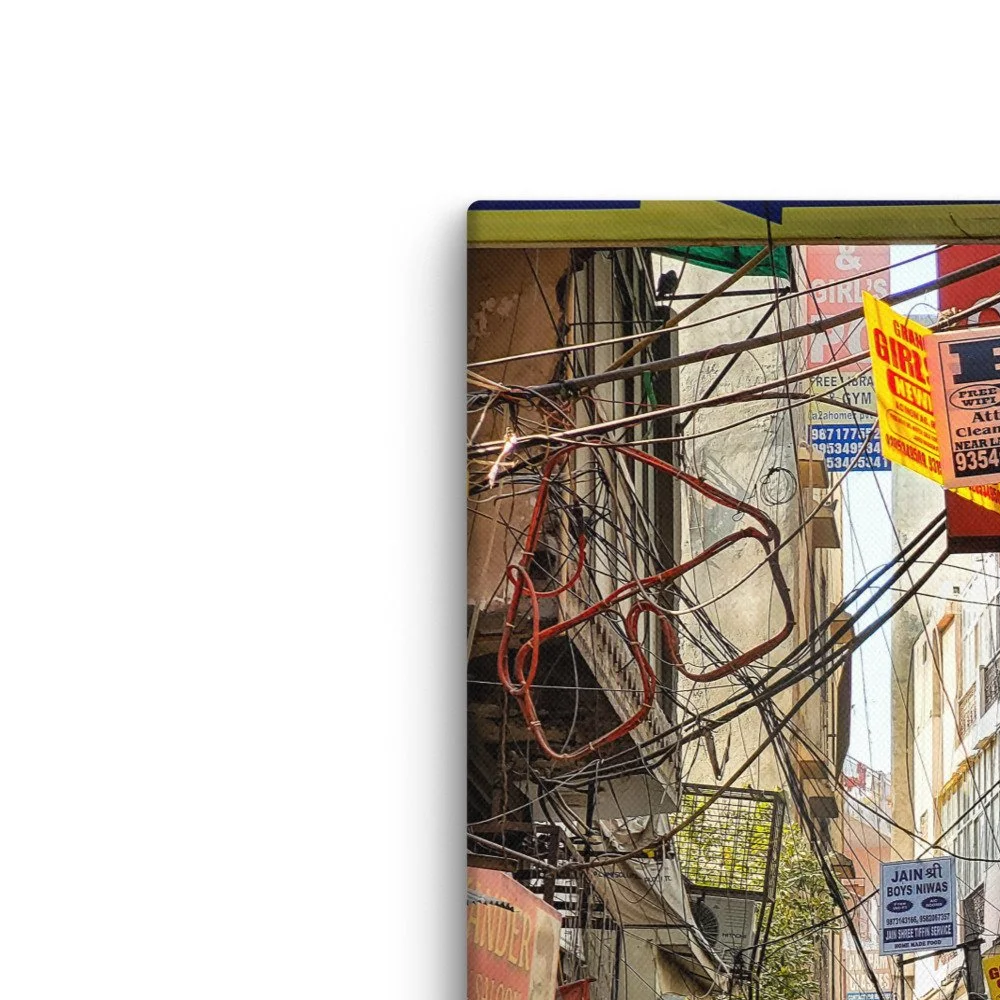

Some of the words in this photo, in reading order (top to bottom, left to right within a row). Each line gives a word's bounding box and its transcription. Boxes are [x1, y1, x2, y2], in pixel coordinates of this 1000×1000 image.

[958, 387, 998, 399] FREE
[961, 396, 996, 407] WIFI
[954, 438, 988, 451] NEAR
[891, 868, 923, 883] JAIN
[887, 884, 912, 897] BOYS
[916, 881, 948, 895] NIWAS
[930, 924, 952, 936] SERVICE
